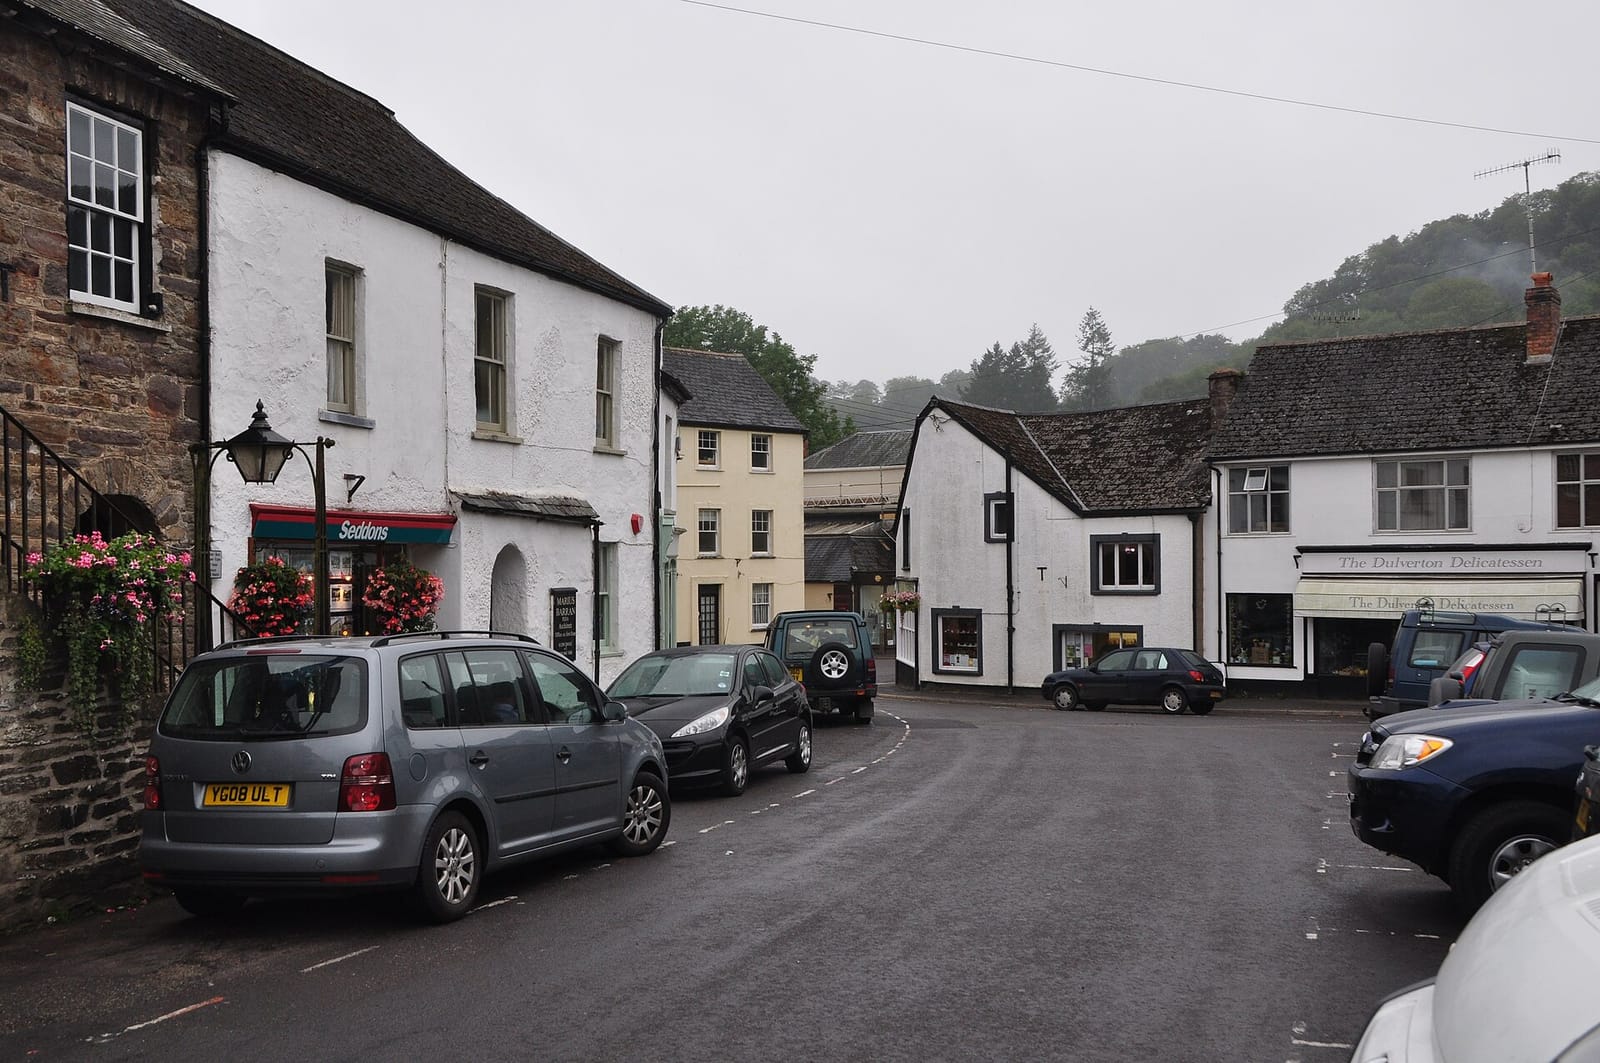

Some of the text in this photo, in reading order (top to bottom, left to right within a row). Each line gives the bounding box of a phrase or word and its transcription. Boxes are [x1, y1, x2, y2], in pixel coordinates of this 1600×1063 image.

[338, 520, 389, 541] Seddons
[1338, 555, 1543, 569] The Dulverton Delicatessen
[1348, 596, 1374, 609] The
[1439, 597, 1515, 610] Delicatessen
[211, 786, 283, 803] YG08 ULT
